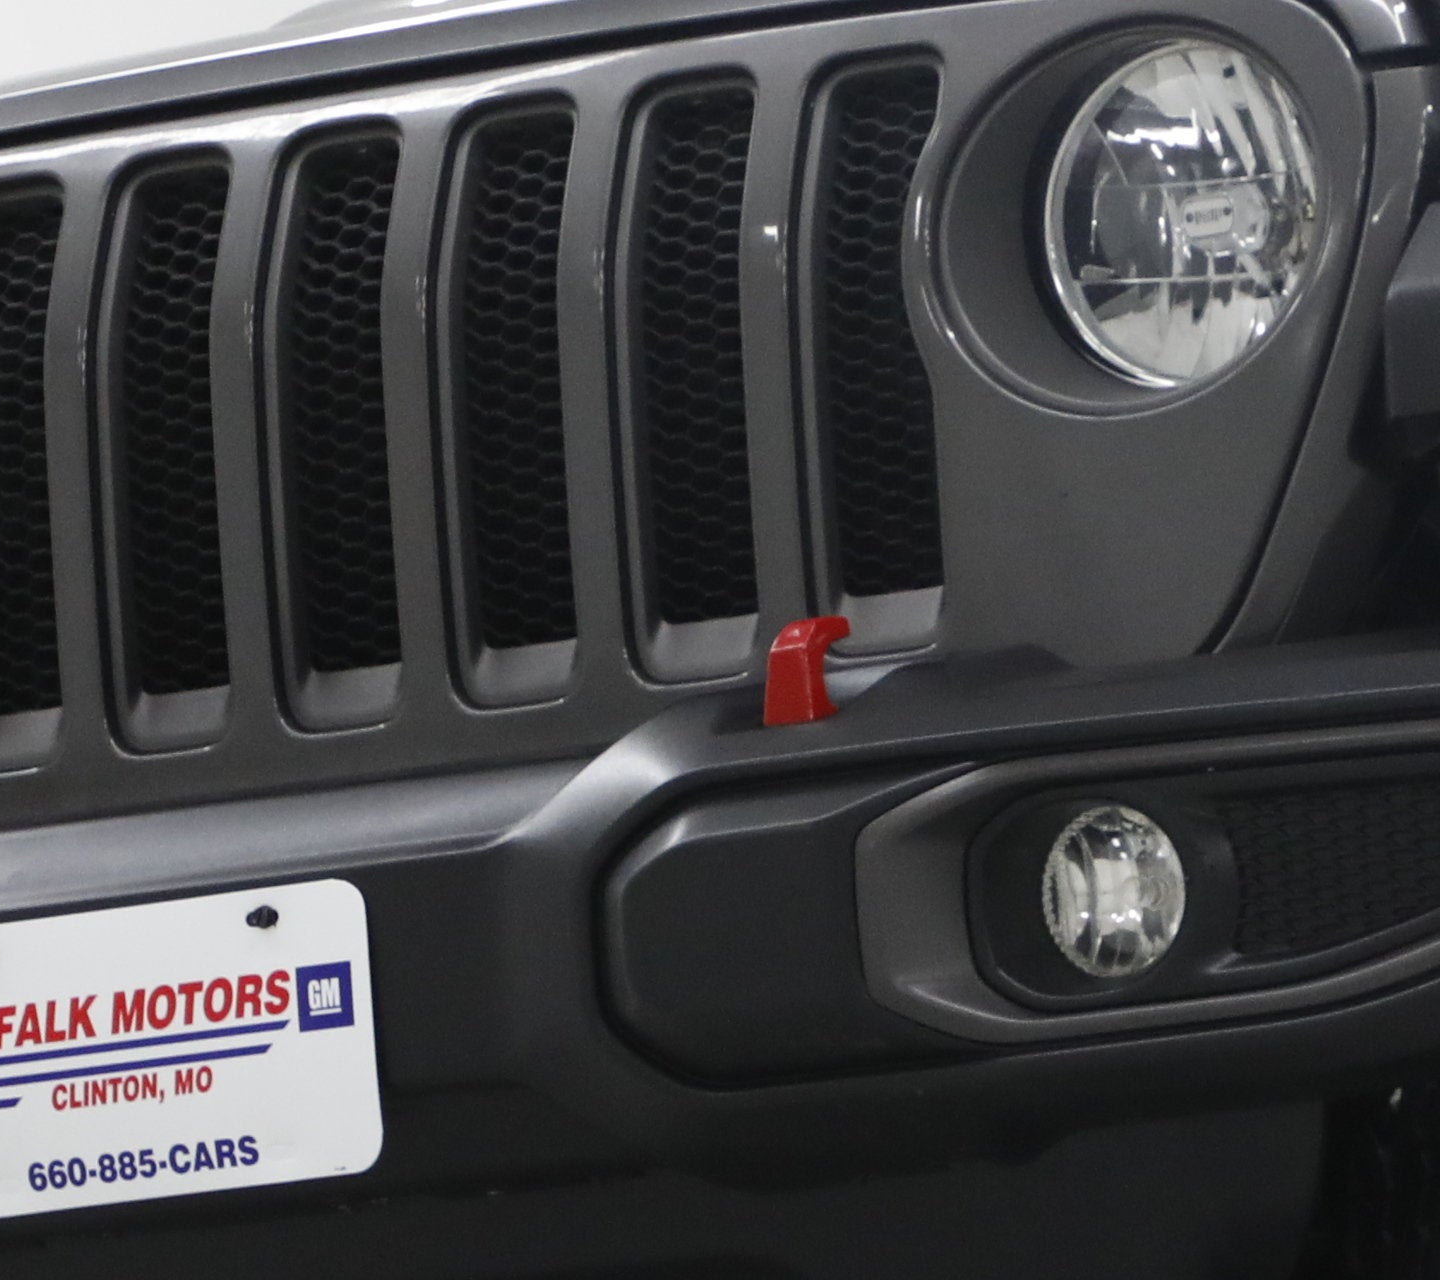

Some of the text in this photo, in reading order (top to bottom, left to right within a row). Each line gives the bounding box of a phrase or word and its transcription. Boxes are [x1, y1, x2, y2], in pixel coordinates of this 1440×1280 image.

[111, 968, 291, 1035] MOTORS
[307, 976, 341, 1011] GM
[51, 1065, 214, 1112] CLINTON, MO
[28, 1134, 260, 1192] 660-885-CARS
